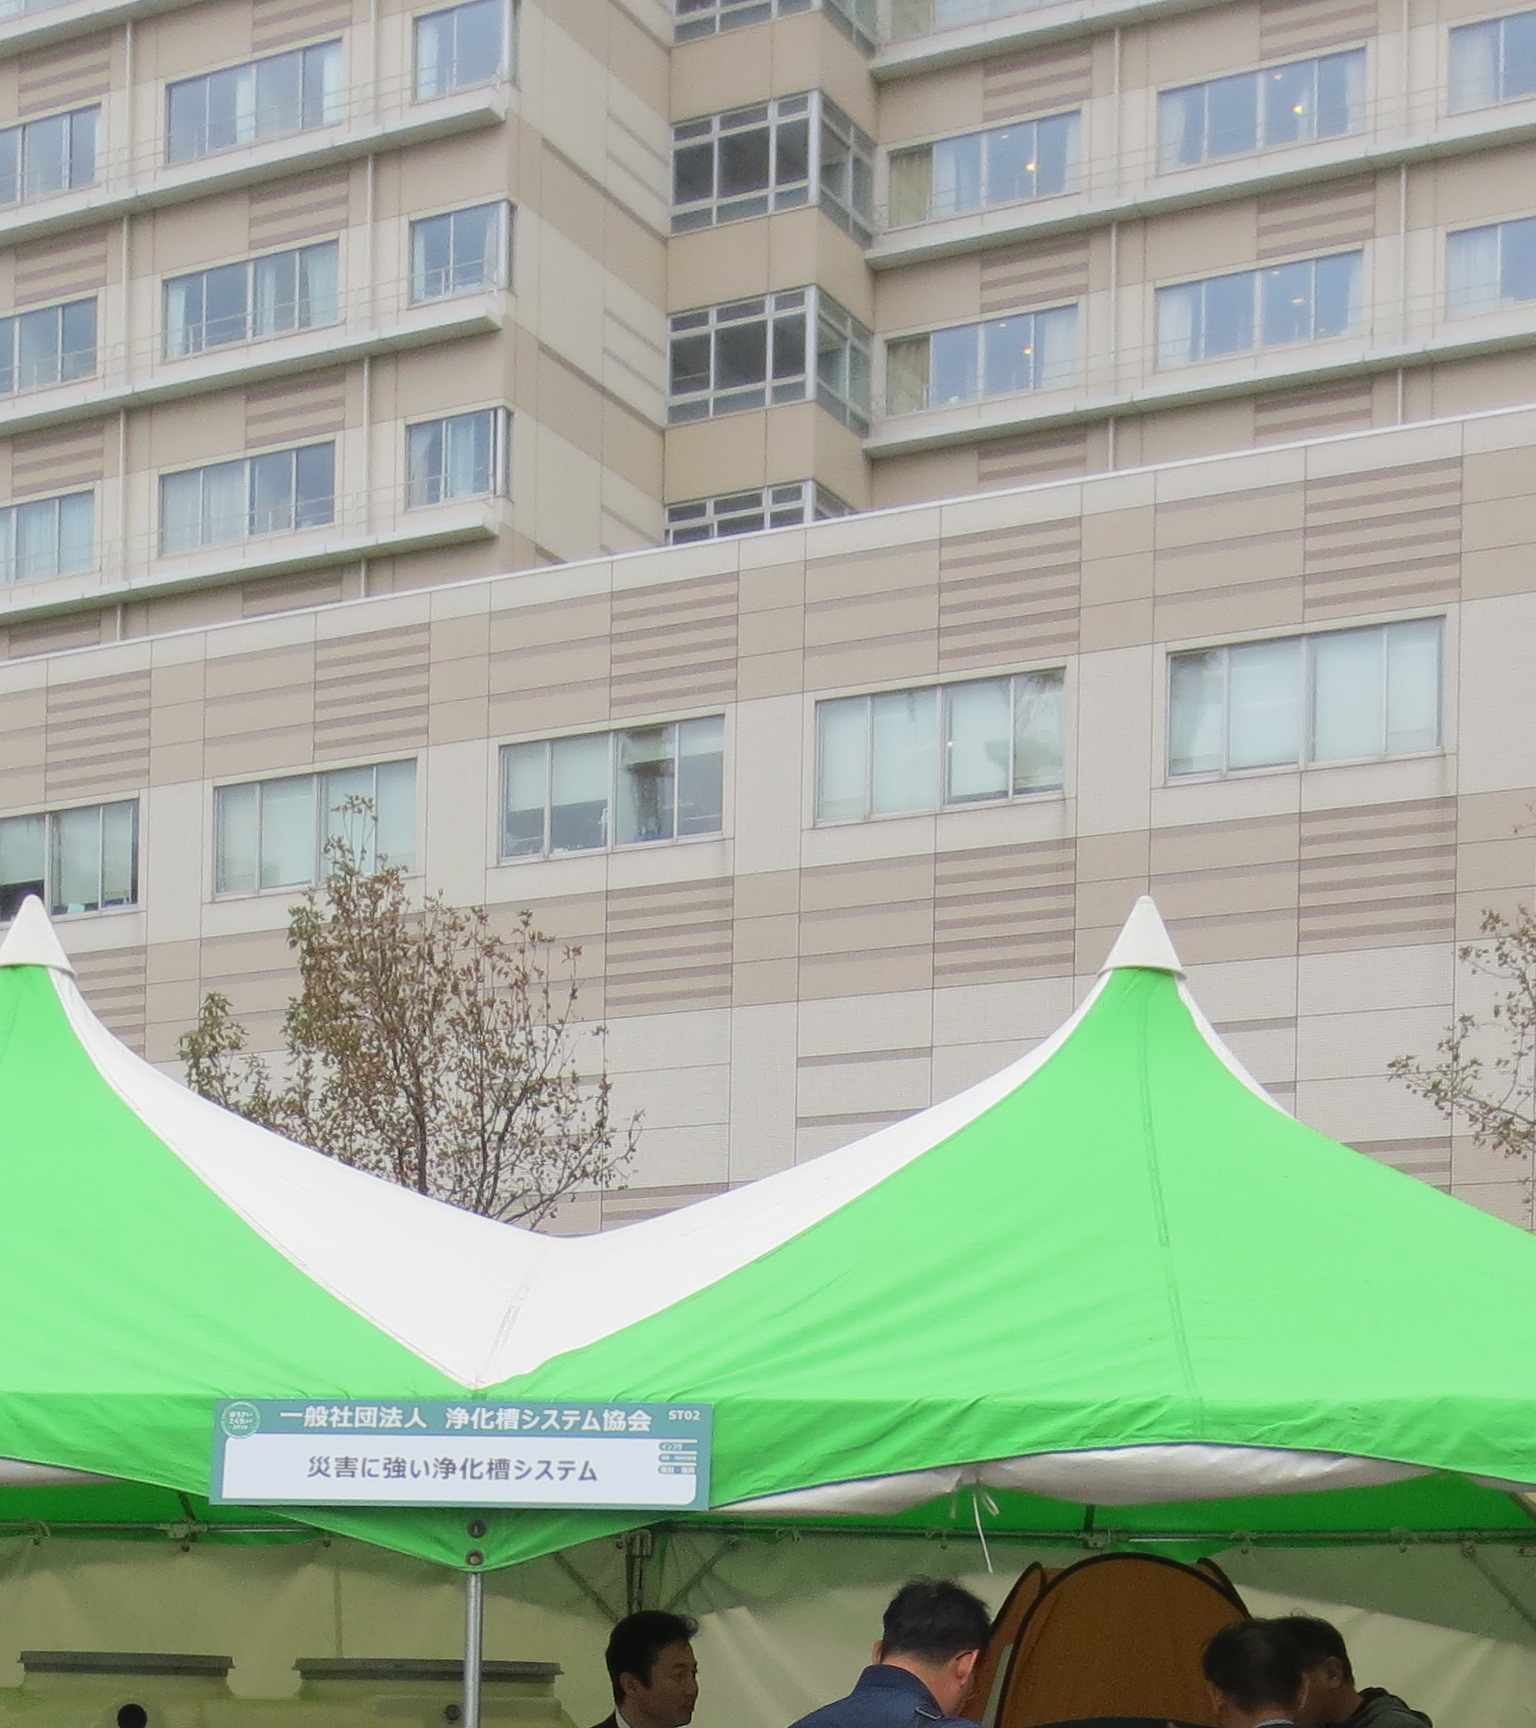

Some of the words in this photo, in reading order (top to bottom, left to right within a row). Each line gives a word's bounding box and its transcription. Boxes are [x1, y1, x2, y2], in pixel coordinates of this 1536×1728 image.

[279, 1405, 428, 1429] 一般社団法人
[445, 1407, 652, 1432] 浄化槽システム協会
[668, 1410, 701, 1421] ST02
[306, 1455, 598, 1482] 災害に強い浄化槽システム
